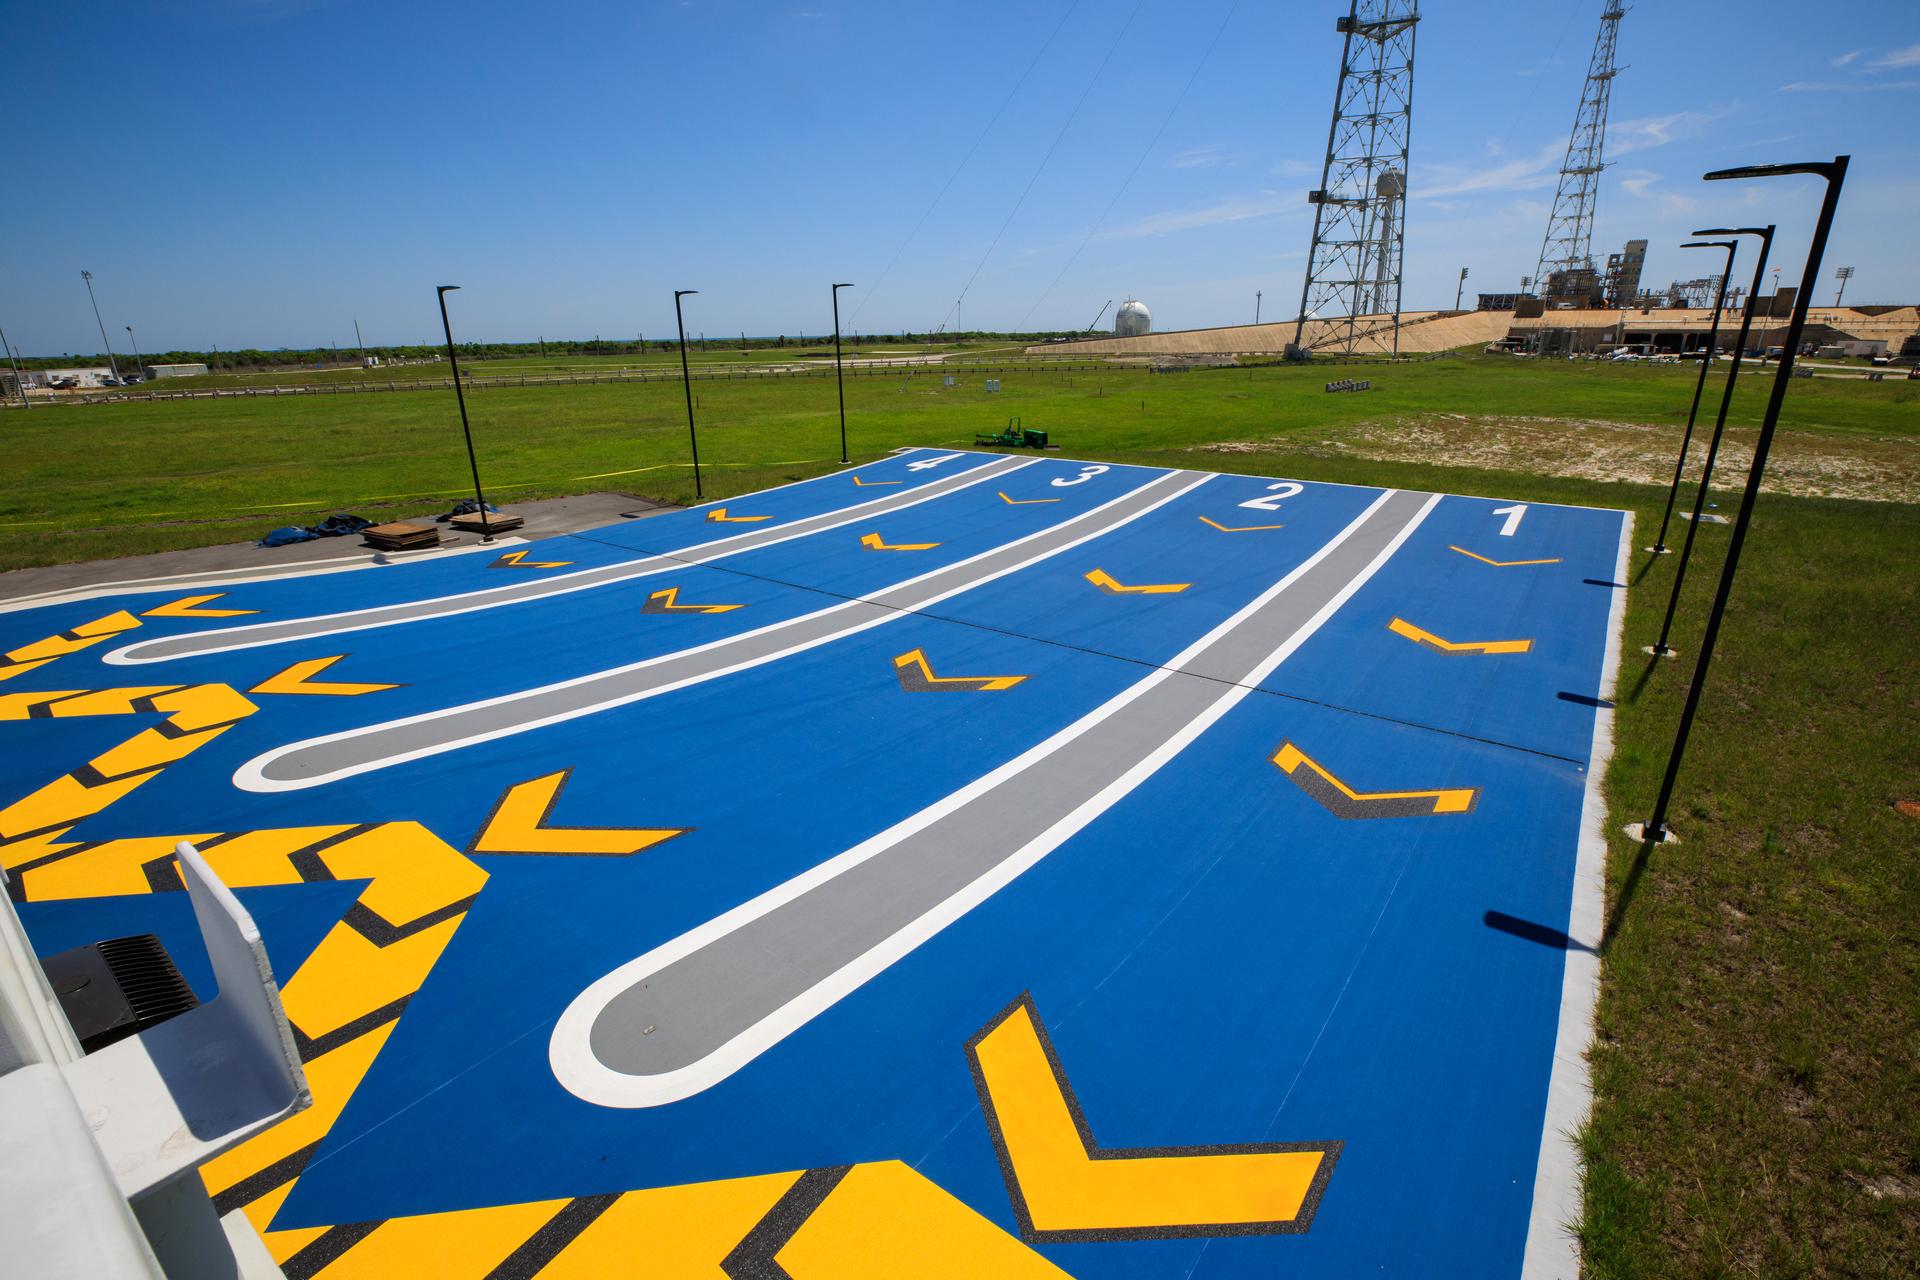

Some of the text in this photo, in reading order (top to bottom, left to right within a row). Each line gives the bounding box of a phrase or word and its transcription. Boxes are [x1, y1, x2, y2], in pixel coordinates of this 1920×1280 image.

[906, 452, 966, 473] 4
[1050, 464, 1110, 488] 3
[1238, 481, 1304, 512] 2
[1491, 504, 1528, 537] 1
